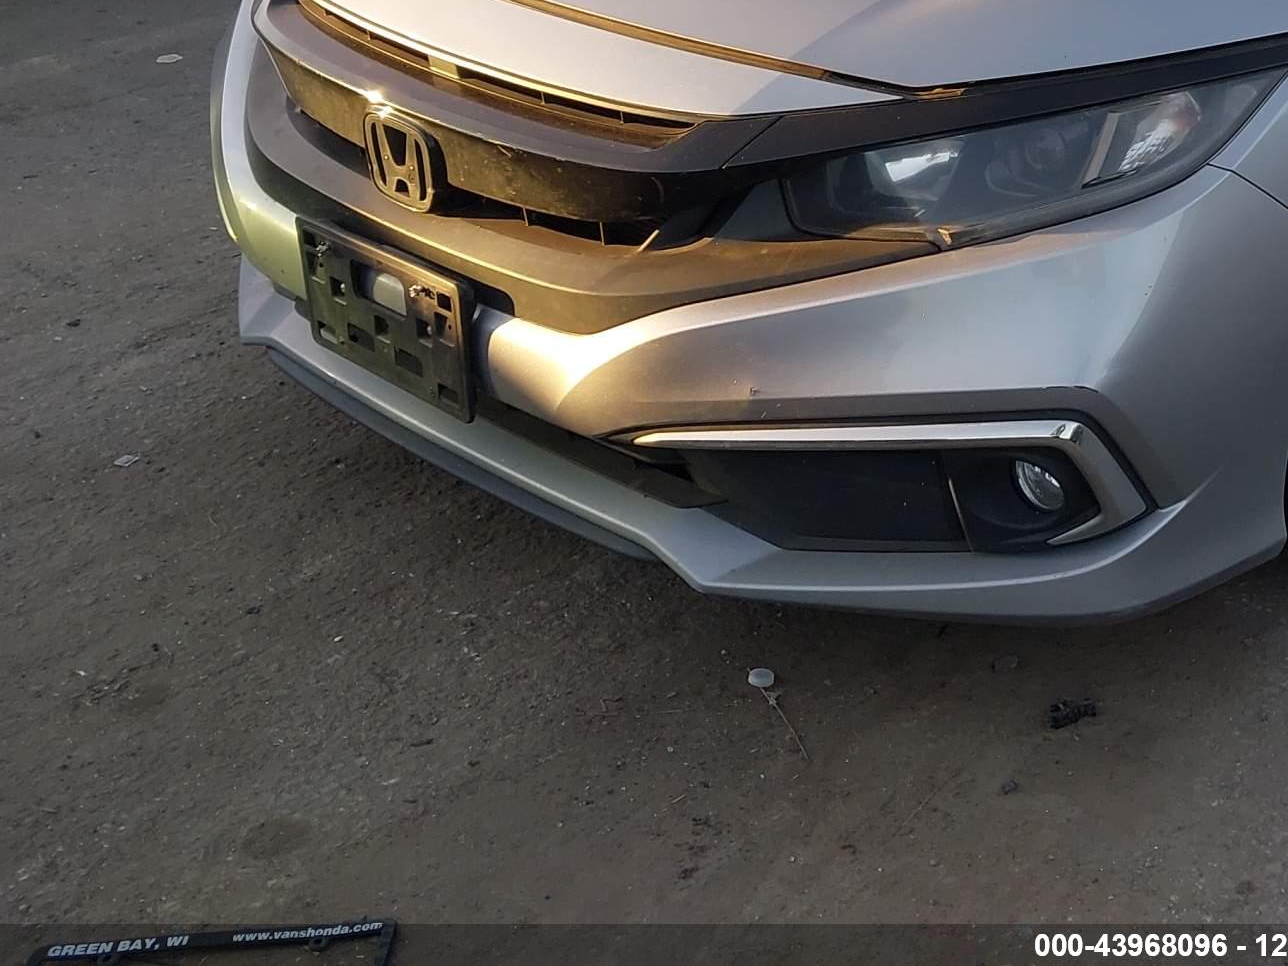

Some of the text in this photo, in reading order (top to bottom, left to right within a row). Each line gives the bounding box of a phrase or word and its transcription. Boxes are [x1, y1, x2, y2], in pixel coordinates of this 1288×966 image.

[47, 922, 383, 957] GREEN BAY, WI www.vanshonda.com
